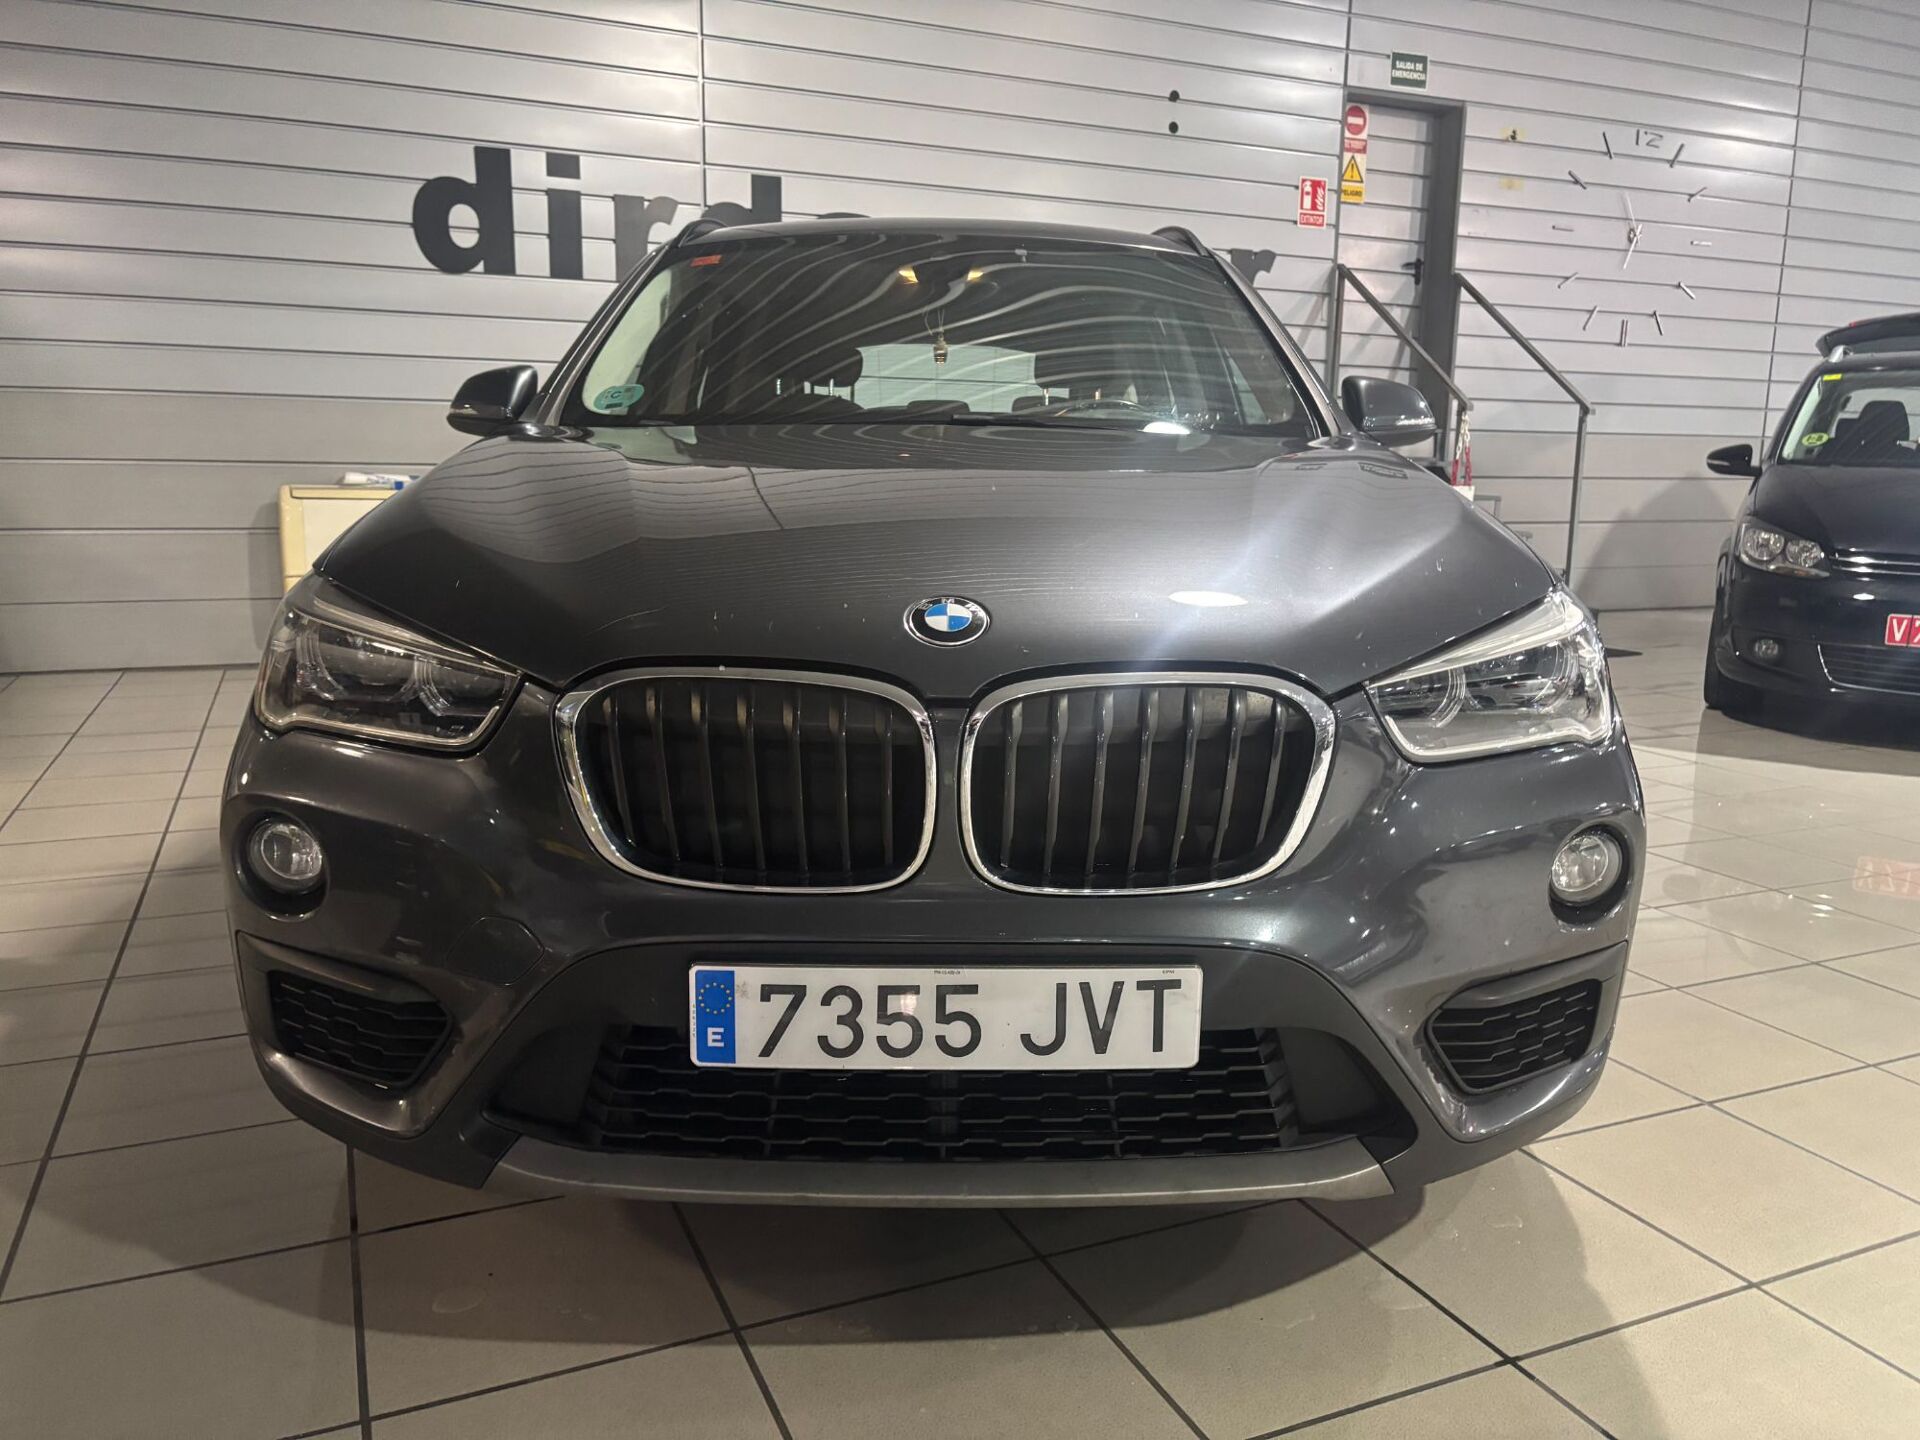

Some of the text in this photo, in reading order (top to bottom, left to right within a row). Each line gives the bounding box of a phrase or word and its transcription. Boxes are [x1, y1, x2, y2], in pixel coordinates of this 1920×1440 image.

[707, 1026, 725, 1048] E
[758, 983, 982, 1058] 7355
[1019, 979, 1182, 1056] JVT
